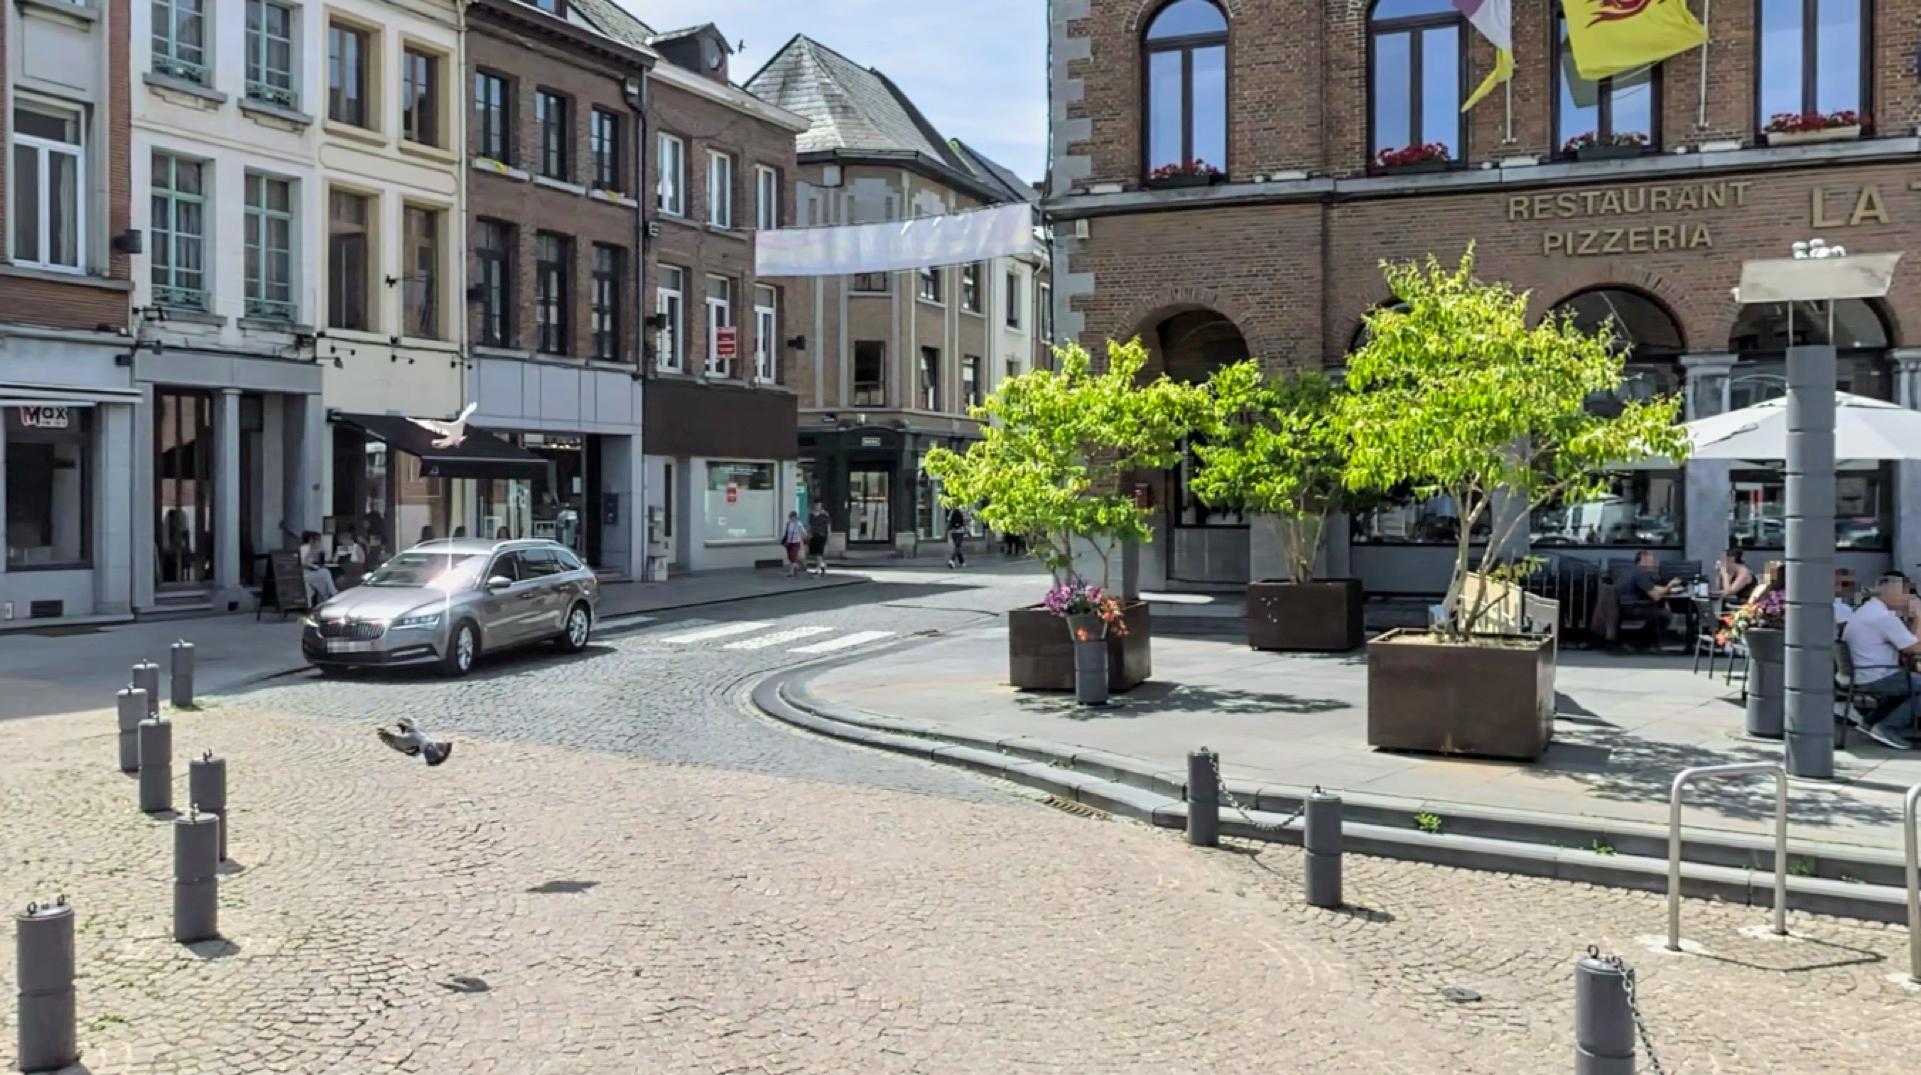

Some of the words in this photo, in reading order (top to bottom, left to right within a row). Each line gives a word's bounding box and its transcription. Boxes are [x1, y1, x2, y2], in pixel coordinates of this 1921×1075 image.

[1507, 181, 1752, 221] RESTAURANT
[1810, 184, 1889, 228] LA
[1542, 223, 1713, 256] PIZZERIA
